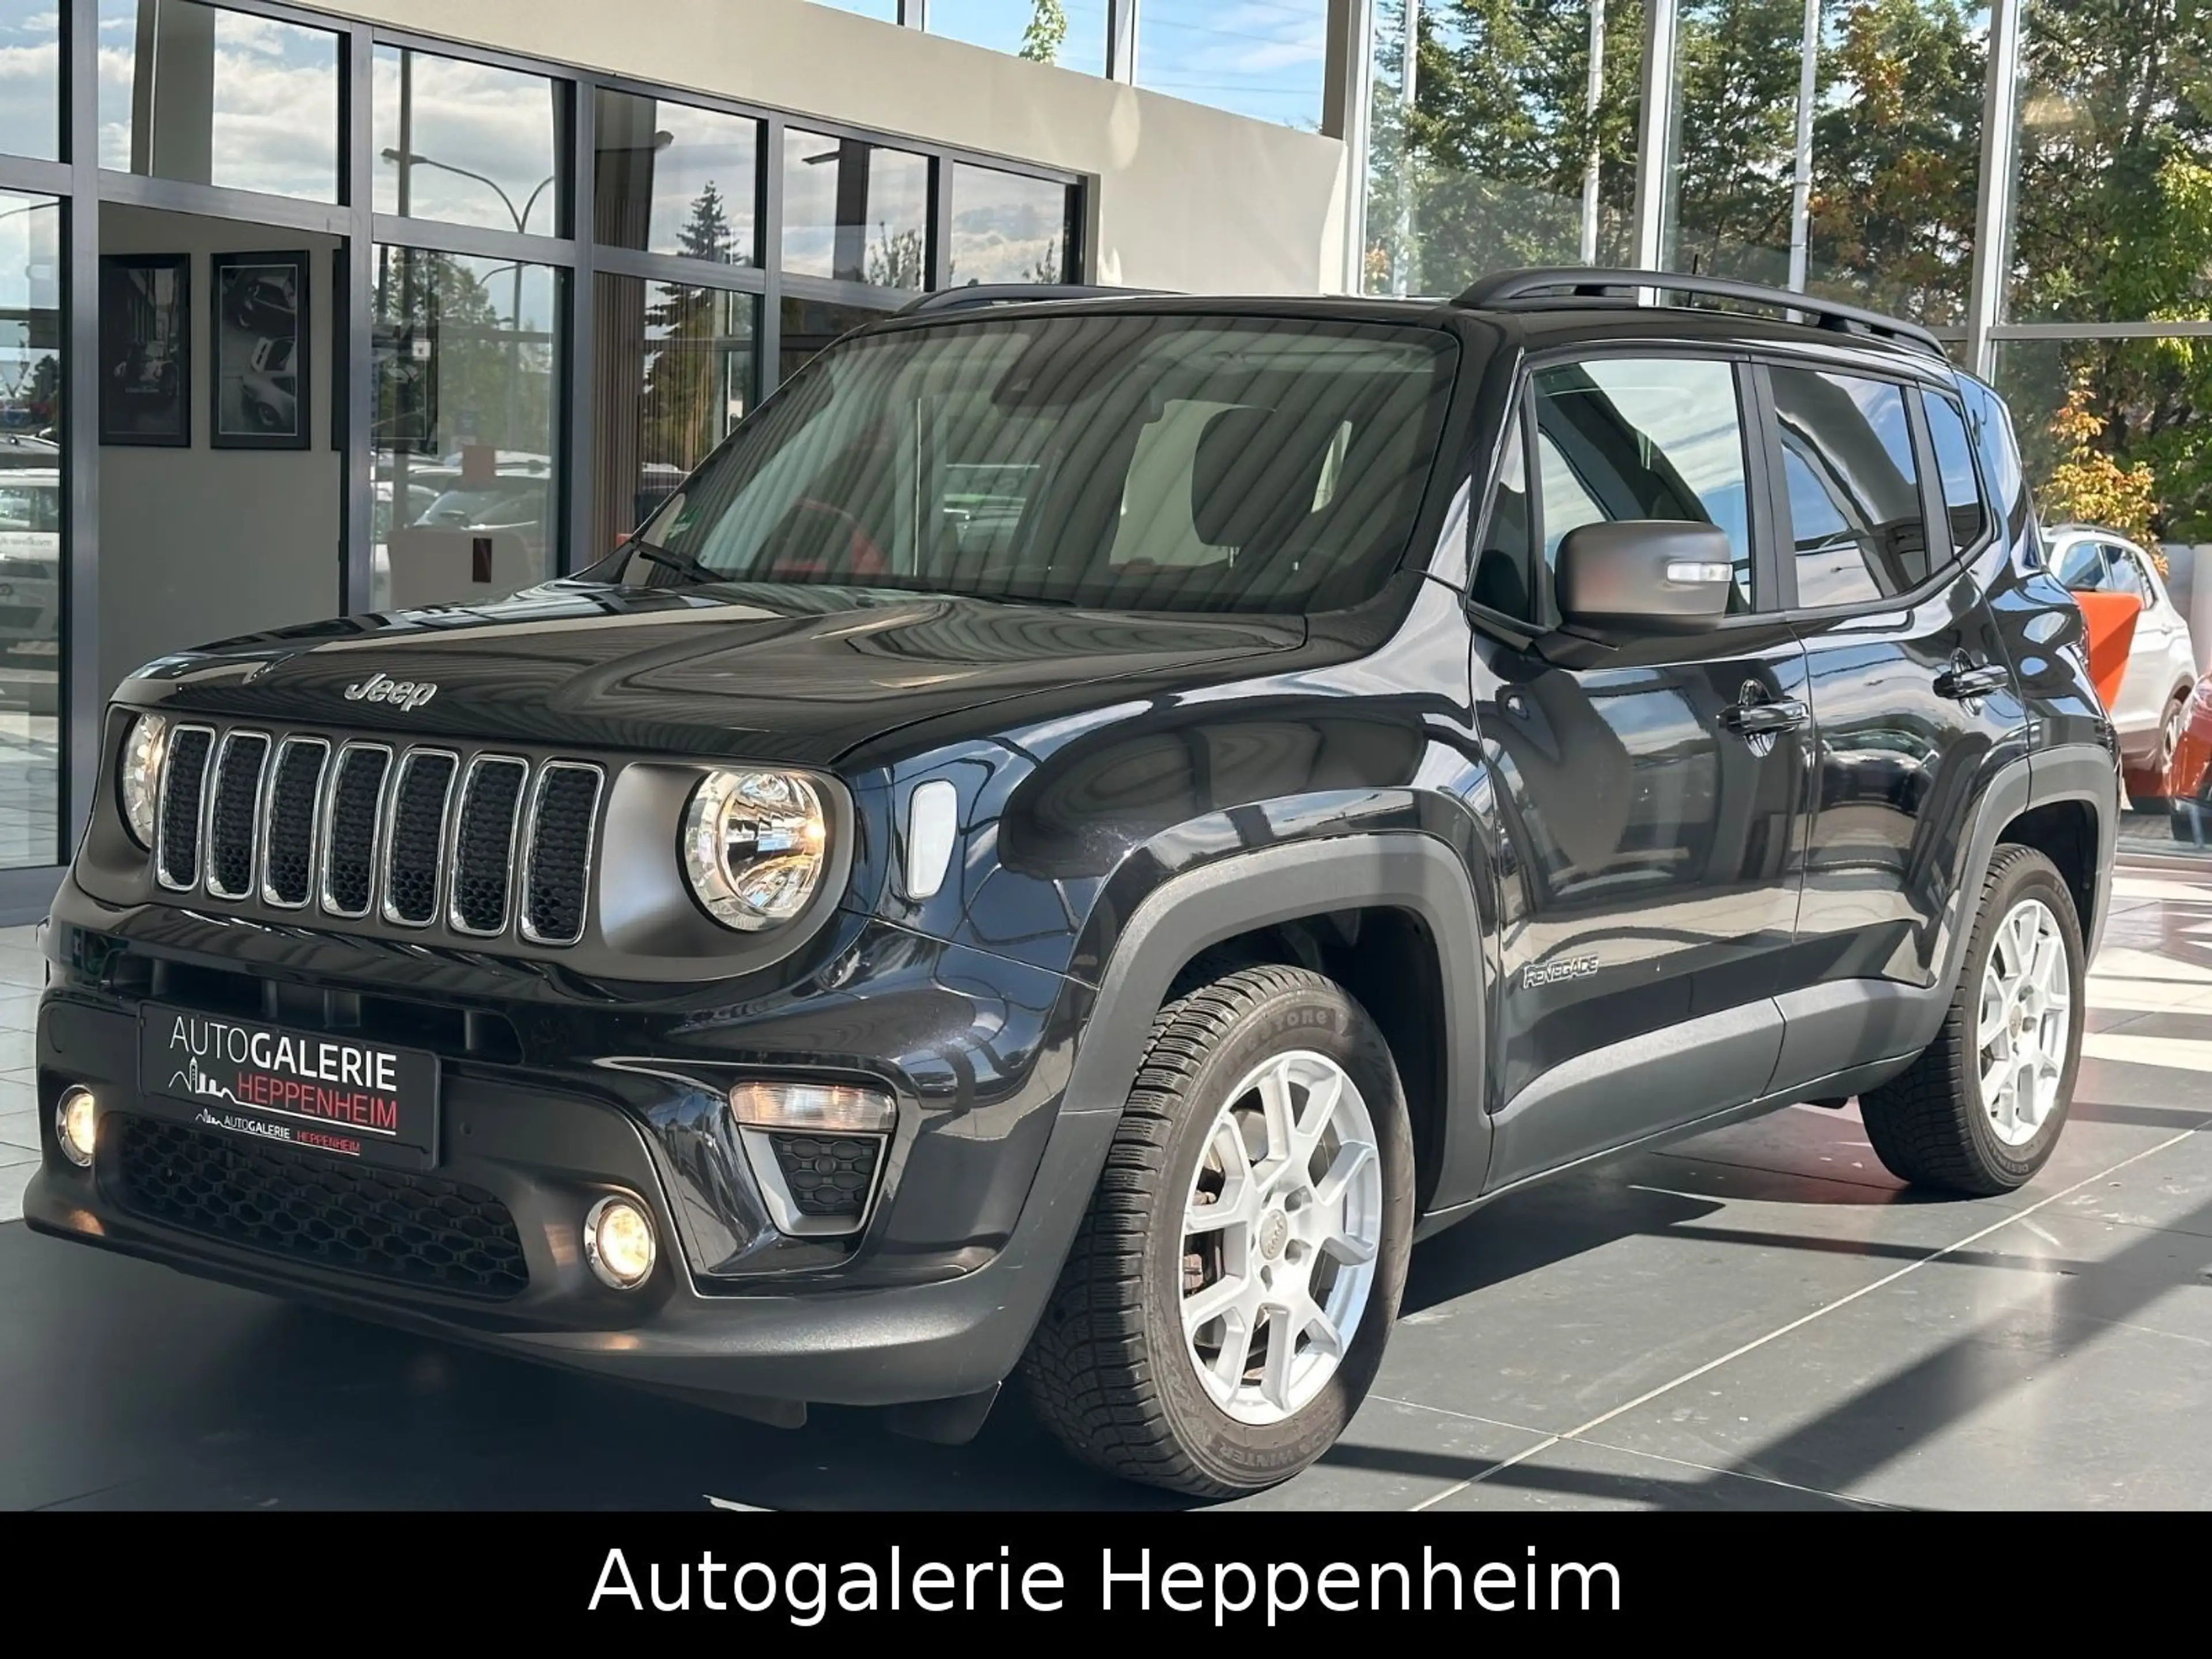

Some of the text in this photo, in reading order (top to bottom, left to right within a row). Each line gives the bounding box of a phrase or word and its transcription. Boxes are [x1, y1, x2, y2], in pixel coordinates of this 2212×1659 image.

[344, 673, 437, 712] Jeep
[169, 1016, 397, 1092] AUTOGALERIE
[237, 1071, 396, 1130] HEPPENHEIM
[224, 1114, 360, 1153] AUTOGALERIE HEPPENHEIM
